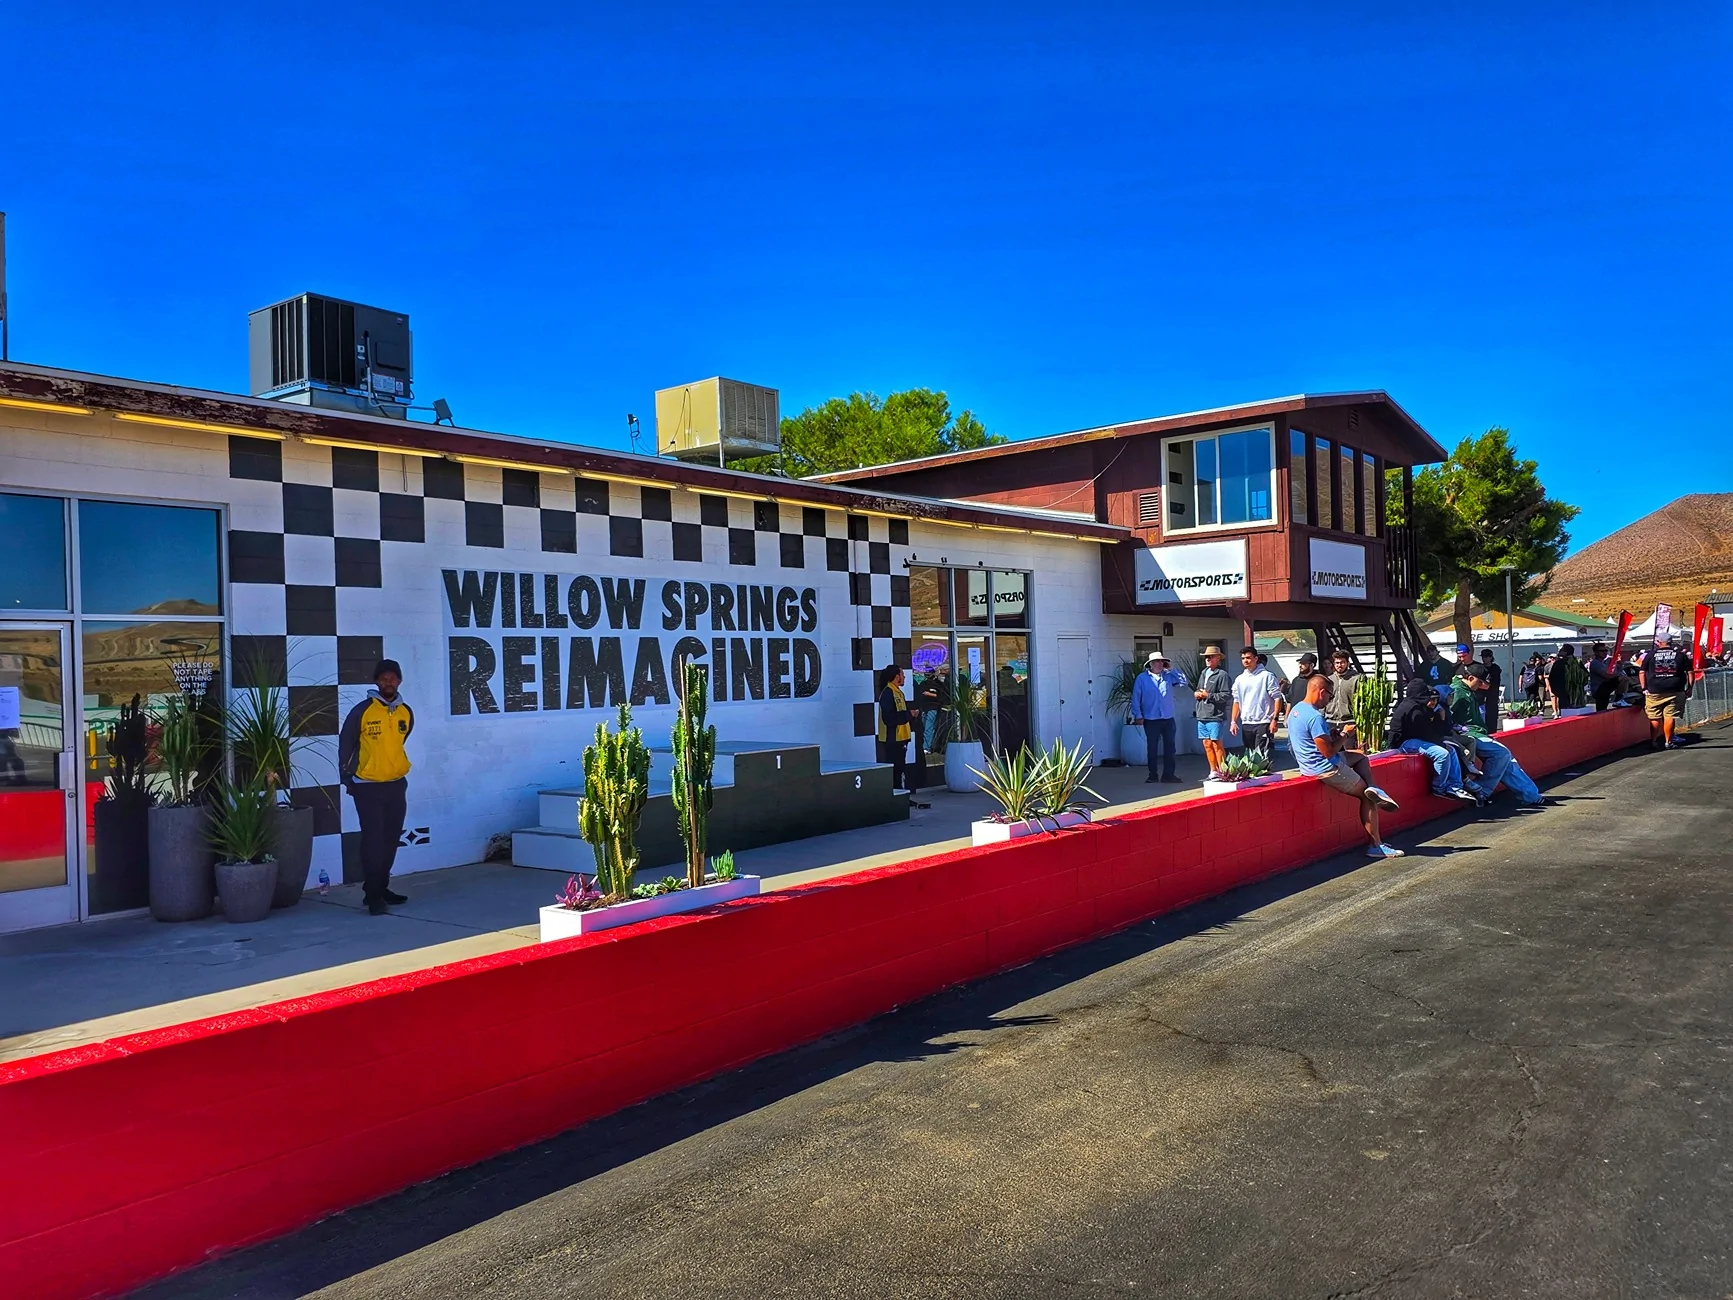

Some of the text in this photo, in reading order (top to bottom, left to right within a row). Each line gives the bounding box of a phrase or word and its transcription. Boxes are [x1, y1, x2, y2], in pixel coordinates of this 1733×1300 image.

[1150, 574, 1234, 591] MOTORSPORTS
[1317, 571, 1362, 588] MOTORSPORTS
[441, 569, 818, 632] WILLOW SPRINGS
[448, 636, 822, 715] REIMAGINED
[1429, 665, 1439, 680] 4
[776, 755, 781, 769] 1
[855, 775, 861, 789] 3
